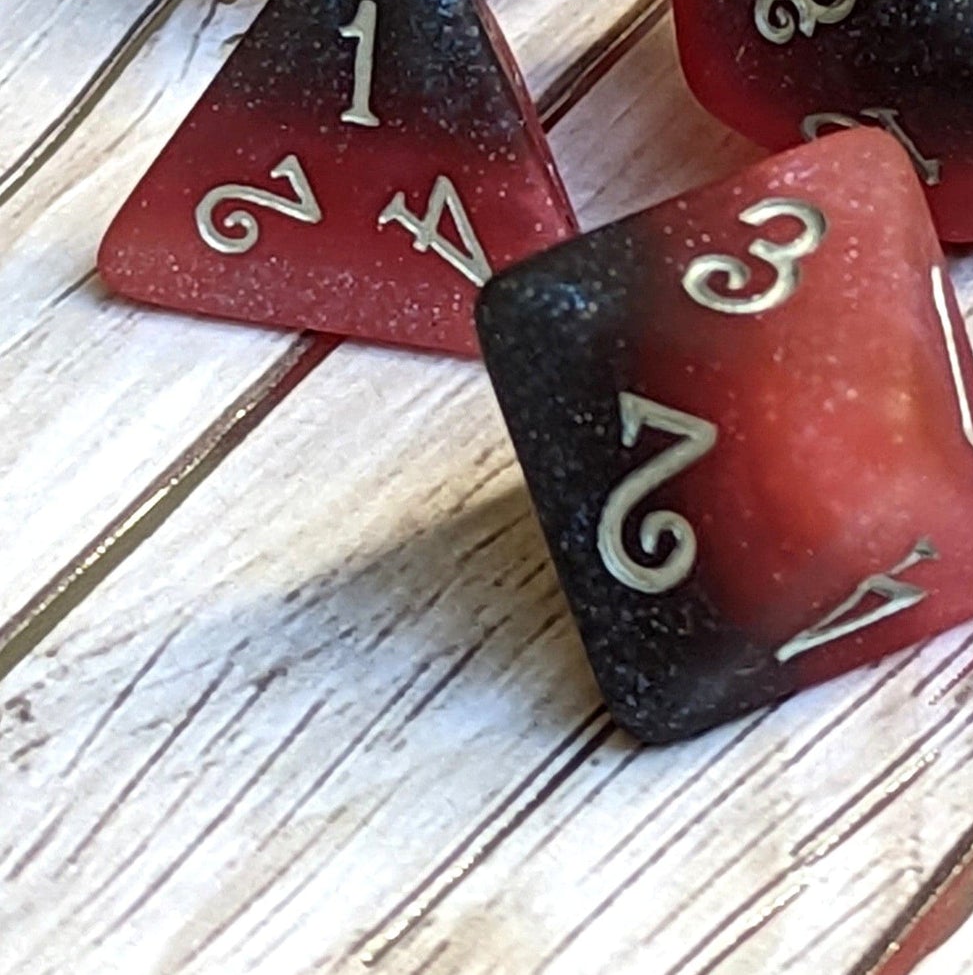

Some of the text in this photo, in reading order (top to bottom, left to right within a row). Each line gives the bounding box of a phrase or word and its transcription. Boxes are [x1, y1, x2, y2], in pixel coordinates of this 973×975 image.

[194, 154, 323, 254] 2
[378, 175, 493, 288] 4
[682, 197, 829, 315] 3
[774, 536, 941, 664] 4
